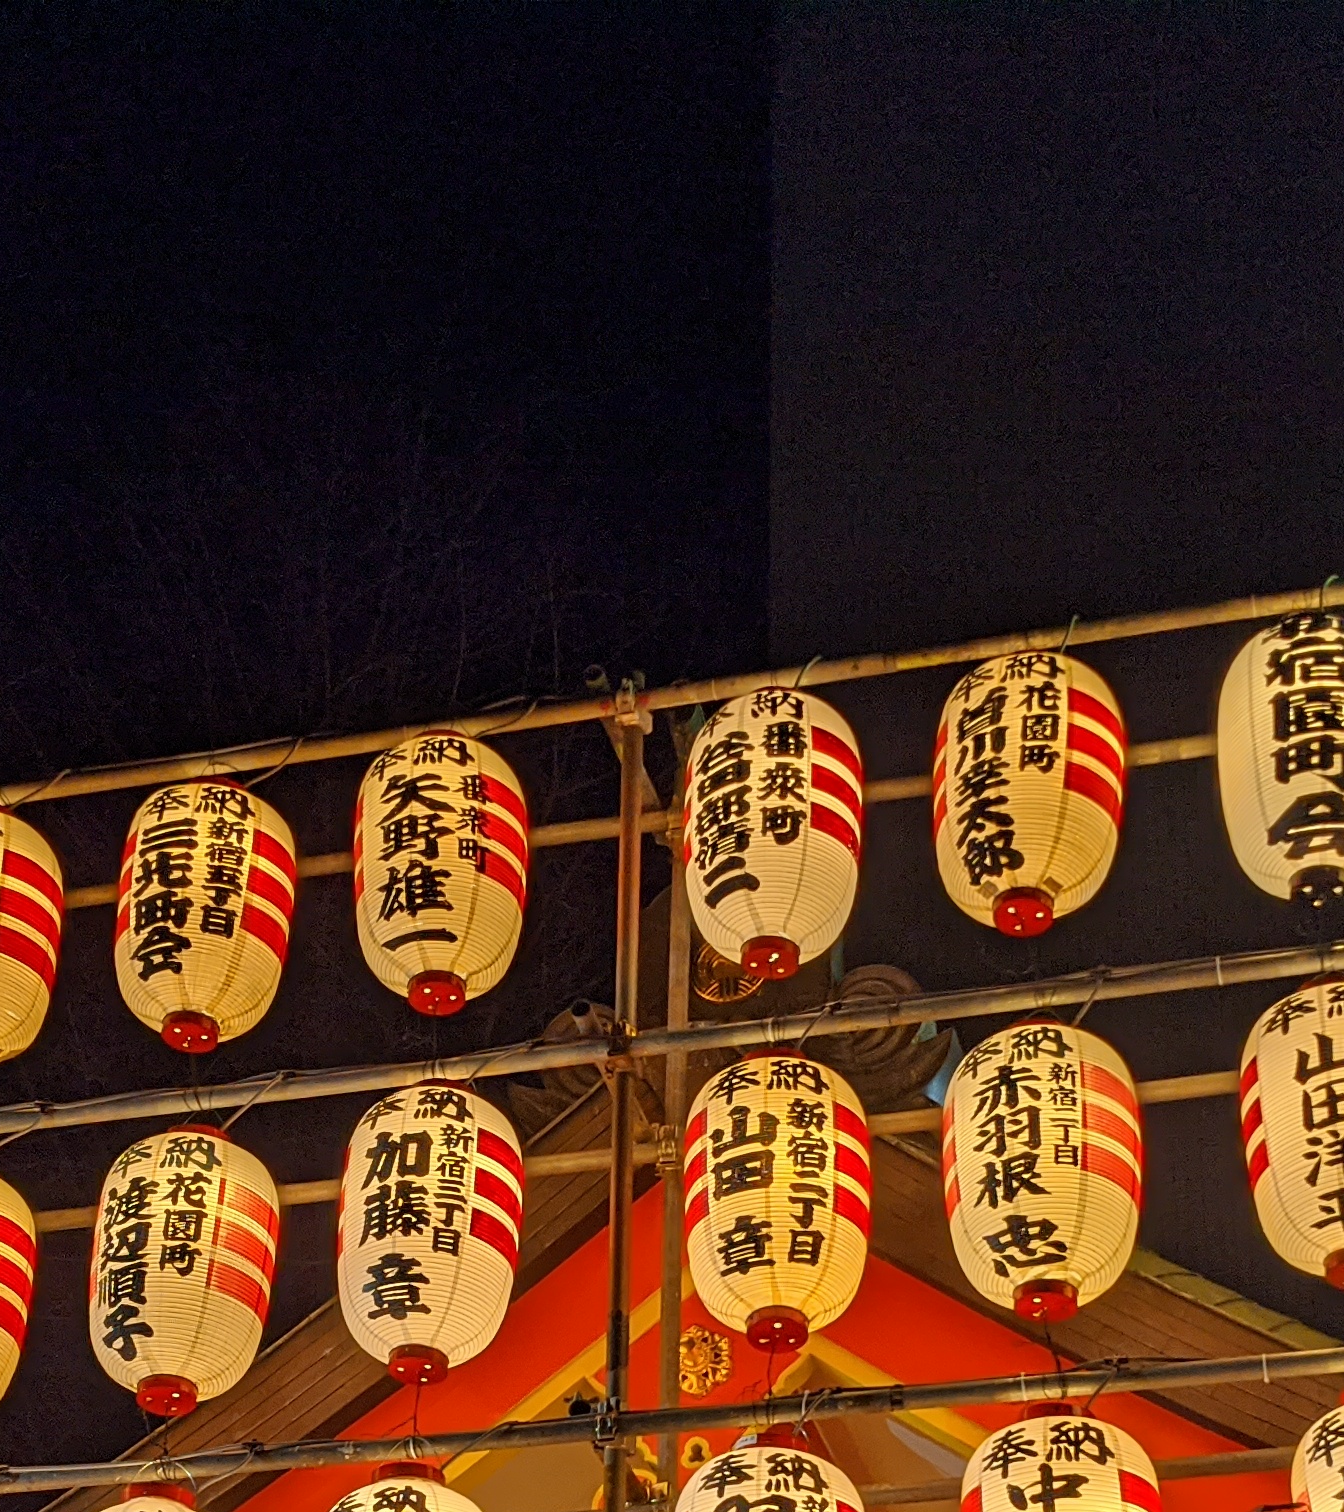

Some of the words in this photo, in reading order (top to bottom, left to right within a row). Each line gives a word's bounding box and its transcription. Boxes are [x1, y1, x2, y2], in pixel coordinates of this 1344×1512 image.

[699, 688, 805, 738] 奉納
[949, 652, 1066, 702] 奉納
[366, 736, 476, 783] 奉納
[1015, 682, 1063, 774] 花園町
[143, 786, 256, 822] 奉納
[756, 721, 809, 847] 番衆町
[199, 816, 250, 940] 新宿五丁目
[374, 772, 459, 952] 矢野雄一
[707, 1059, 830, 1106] 奉納
[955, 1026, 1074, 1082] 奉納
[359, 1087, 474, 1131] 奉納
[1046, 1061, 1083, 1169] 新宿二丁目
[111, 1135, 224, 1178] 奉納
[430, 1122, 475, 1257] 新宿三丁目
[708, 1104, 782, 1279] 山田章
[785, 1097, 831, 1268] 新宿二丁目
[971, 1065, 1071, 1279] 赤羽根忠
[158, 1171, 215, 1278] 花園町
[356, 1129, 435, 1323] 加藤章
[697, 1451, 830, 1499] 奉納
[981, 1420, 1116, 1481] 奉納
